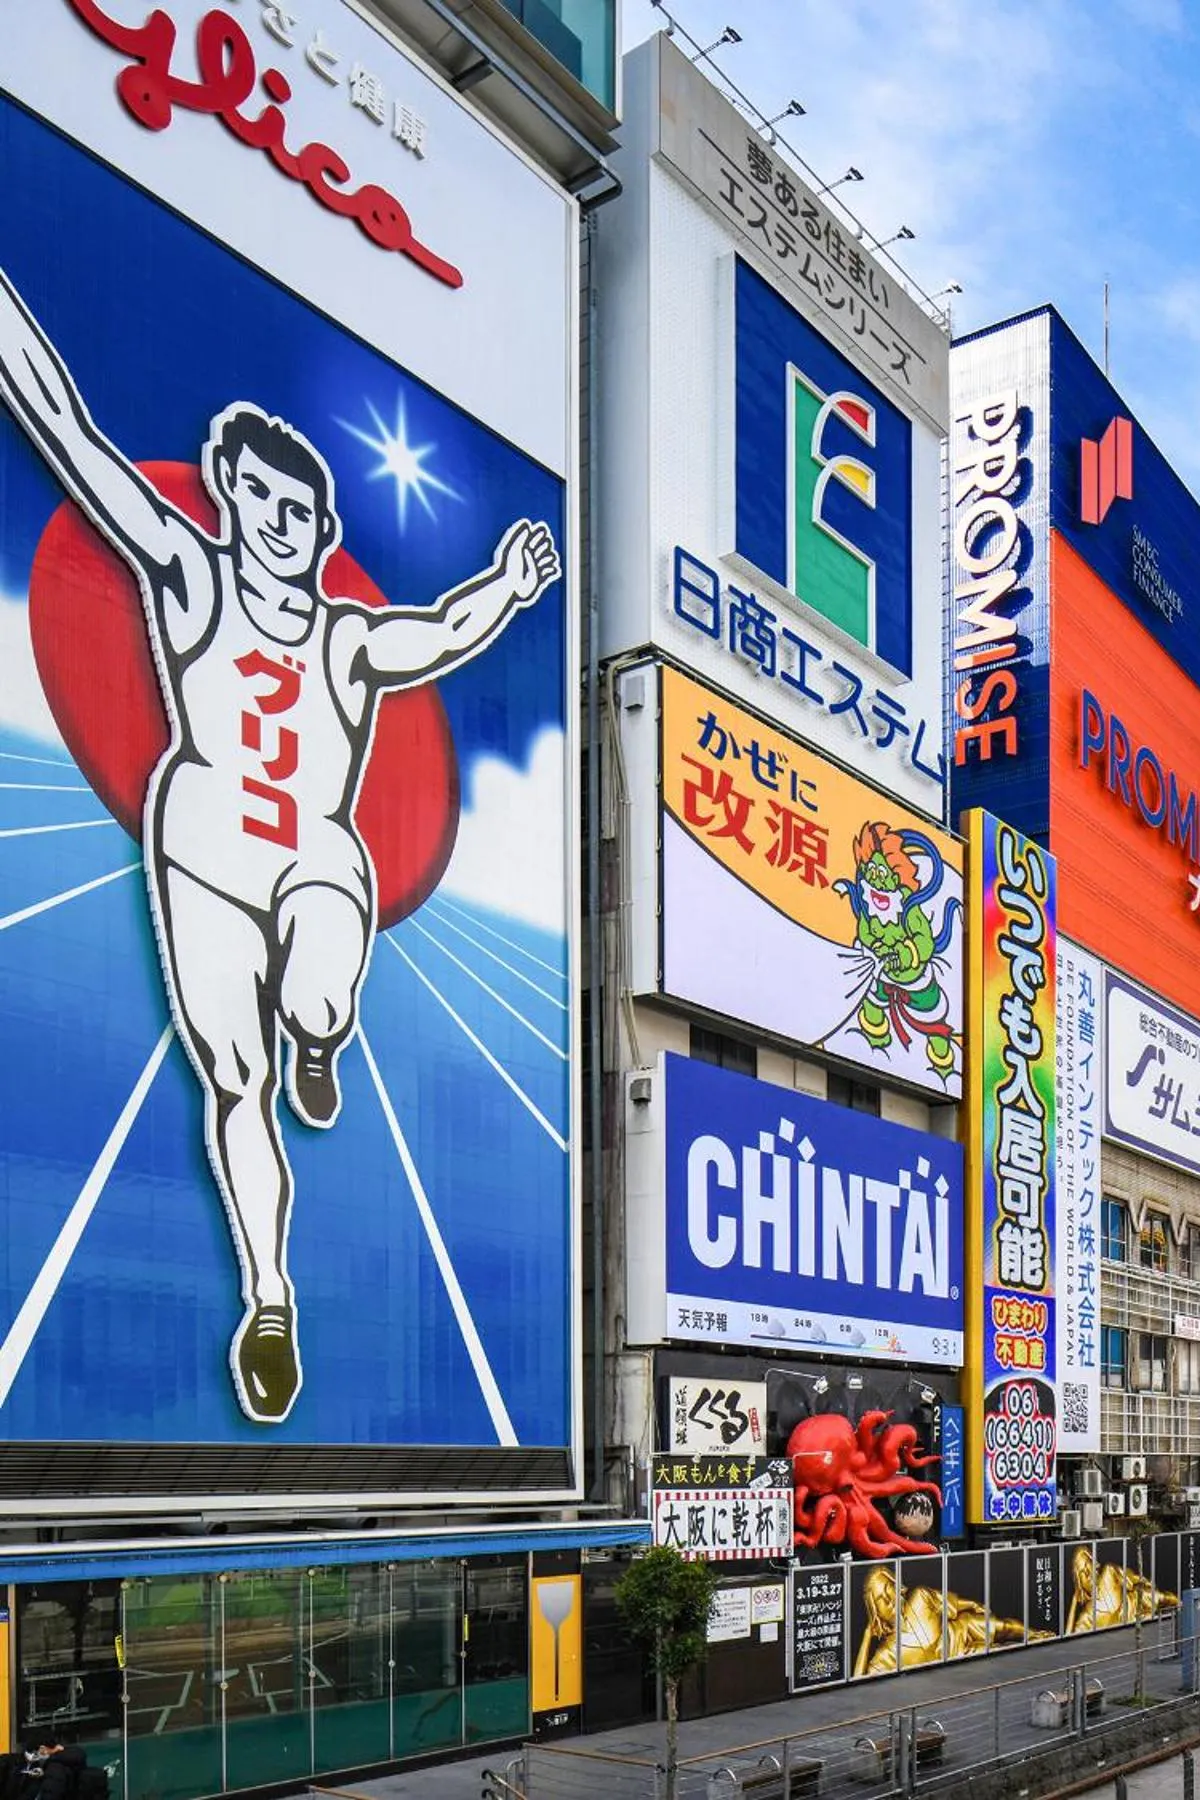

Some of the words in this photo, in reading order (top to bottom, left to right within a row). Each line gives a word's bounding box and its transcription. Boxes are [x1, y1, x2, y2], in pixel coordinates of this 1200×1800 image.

[747, 137, 889, 308] 夢ある住まい
[718, 167, 912, 385] エステムシリーズ
[954, 388, 1018, 766] PROMISE
[674, 545, 945, 786] 日商エステム
[233, 649, 306, 851] グリコ
[696, 711, 819, 813] かぜに
[681, 752, 831, 890] 改源
[998, 827, 1045, 1288] いつでも入居可能
[1066, 992, 1075, 1120] FOUNDATION
[1066, 1128, 1075, 1155] OF
[687, 1117, 950, 1299] CHINTAI
[1066, 1208, 1075, 1278] WORLD
[678, 1308, 728, 1333] 天気予報
[992, 1297, 1047, 1334] ひまわり
[1066, 1302, 1075, 1367] JAPAN
[995, 1335, 1045, 1370] 不動産
[688, 1387, 750, 1445] くくる
[986, 1418, 1052, 1451] (6641)
[1007, 1386, 1034, 1417] 06
[994, 1452, 1046, 1482] 6304
[662, 1500, 774, 1548] 大阪に乾杯
[990, 1491, 1052, 1518] 年中無休
